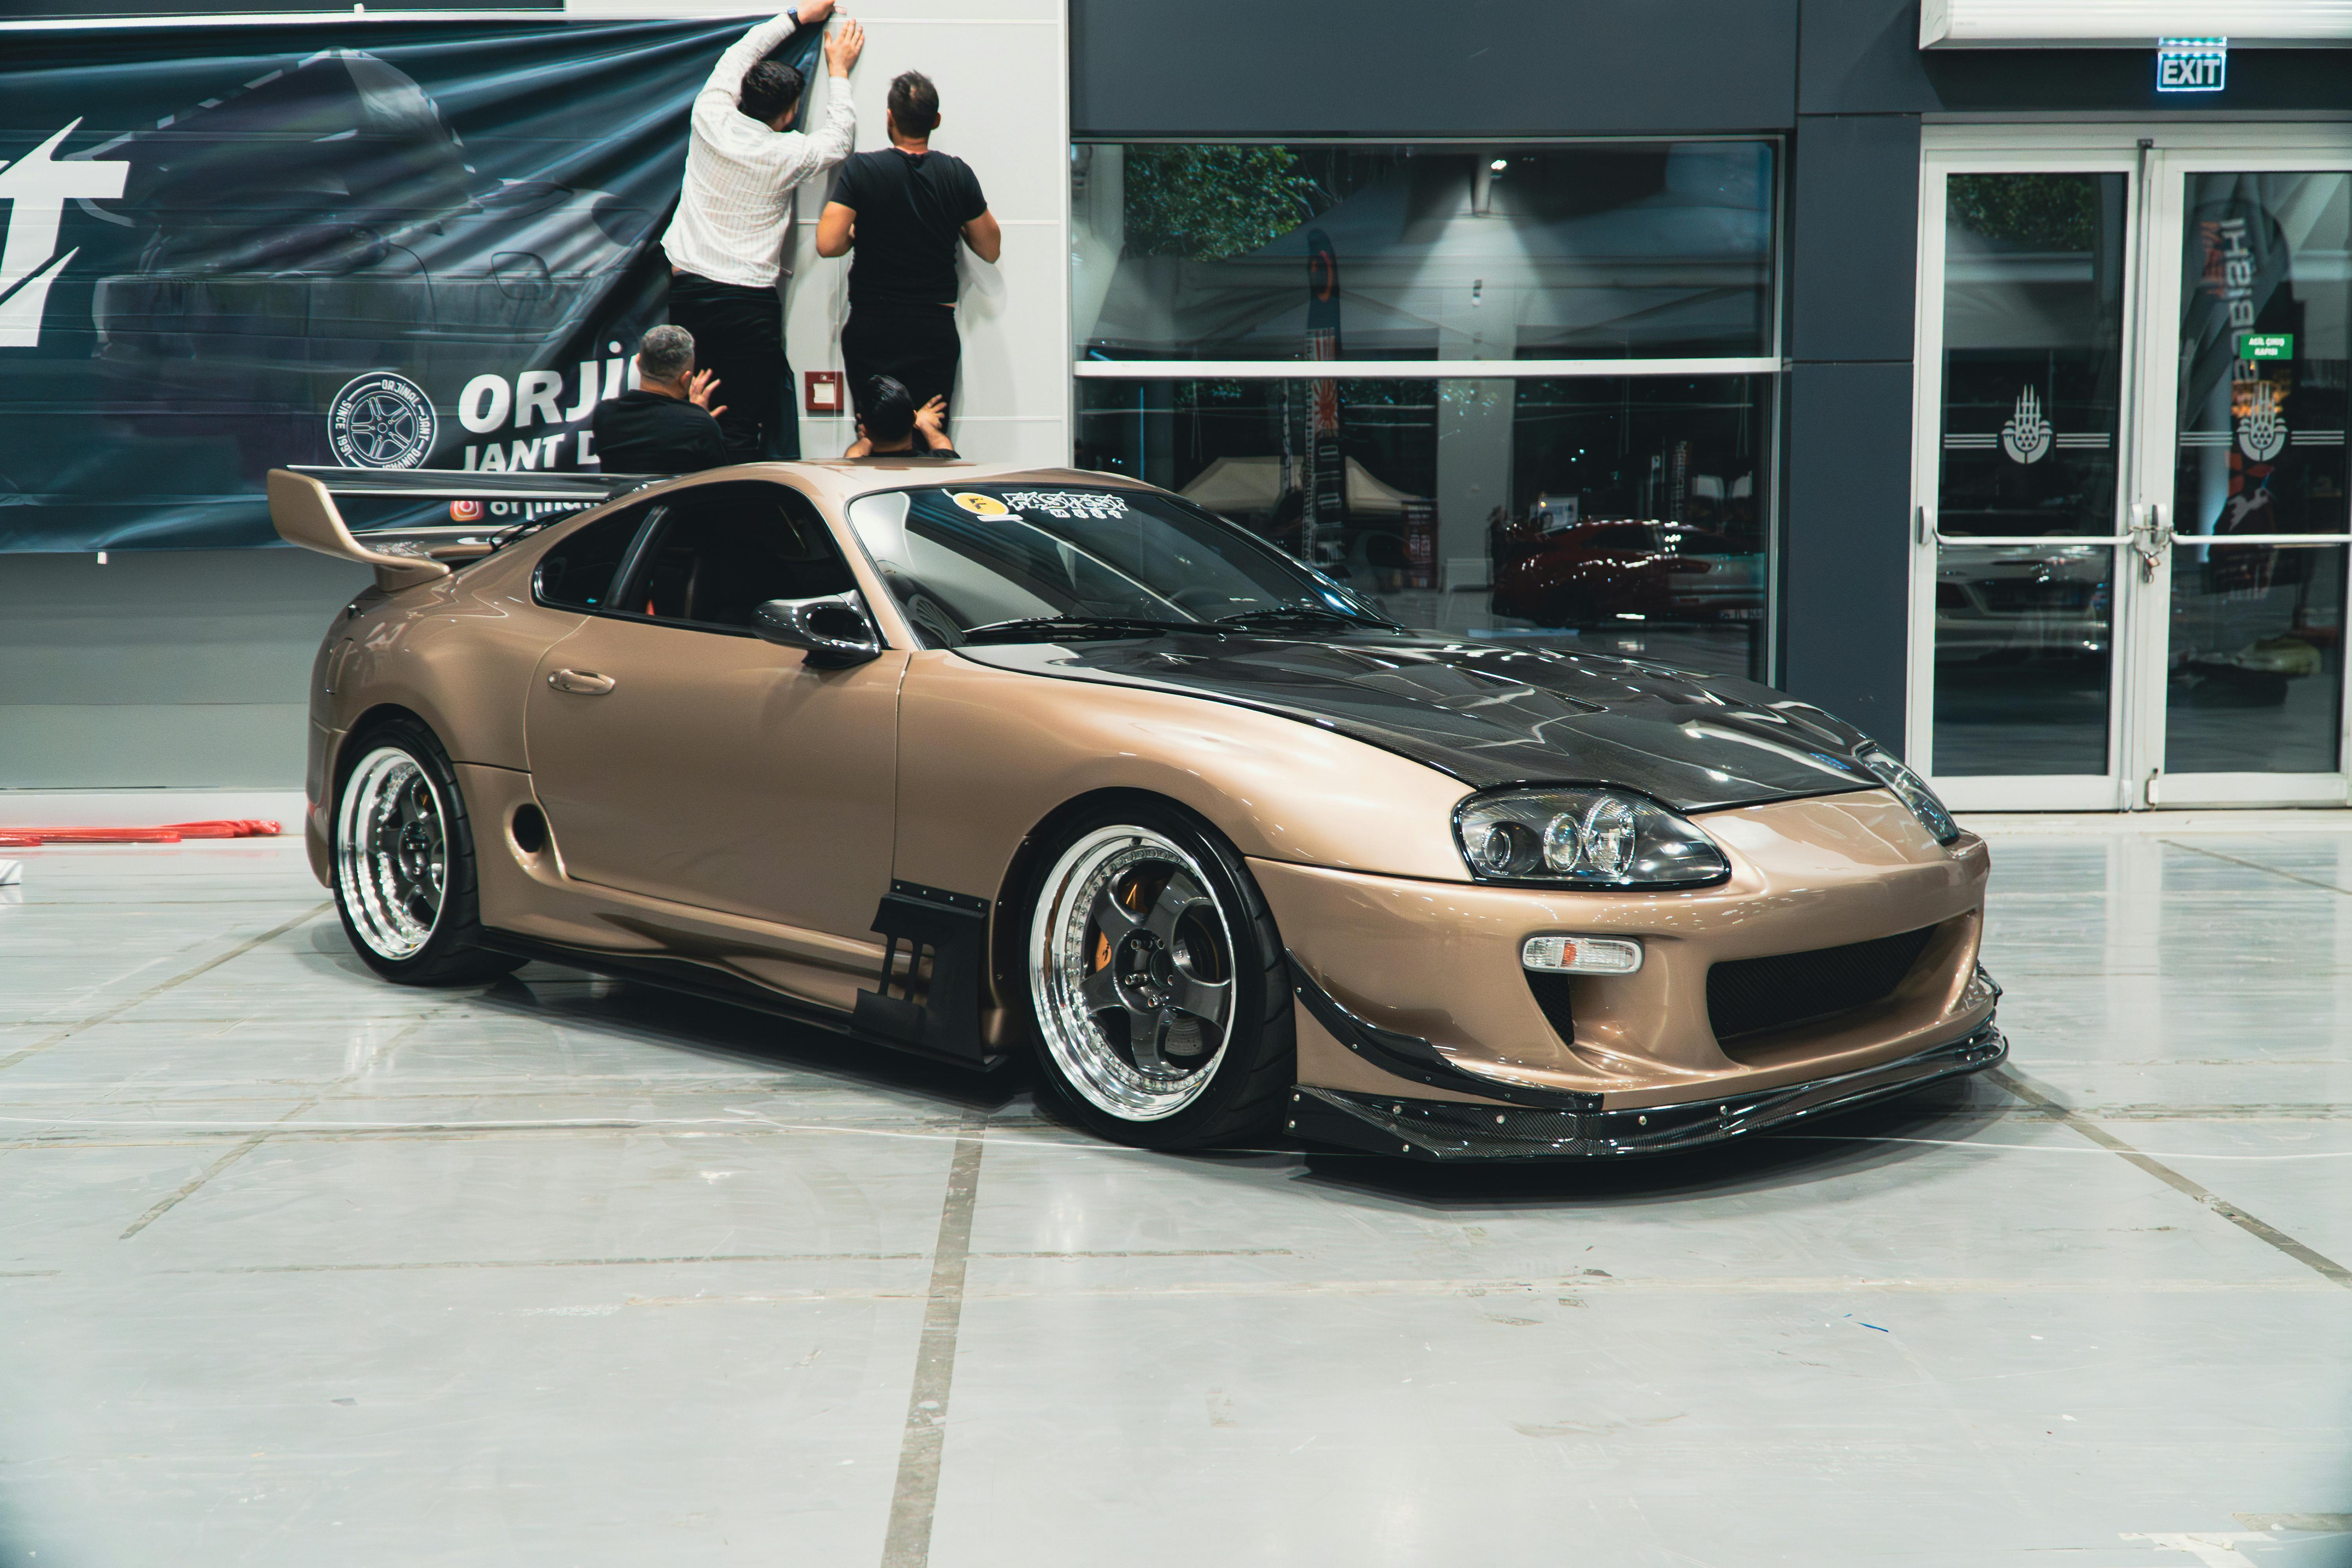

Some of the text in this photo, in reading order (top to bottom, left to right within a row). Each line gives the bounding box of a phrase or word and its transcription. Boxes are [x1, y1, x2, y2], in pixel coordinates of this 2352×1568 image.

[2162, 58, 2220, 85] EXIT
[335, 400, 353, 457] SINCE 1991
[381, 379, 420, 407] ORJİNAL
[418, 414, 430, 441] JANT
[463, 434, 565, 471] JANT
